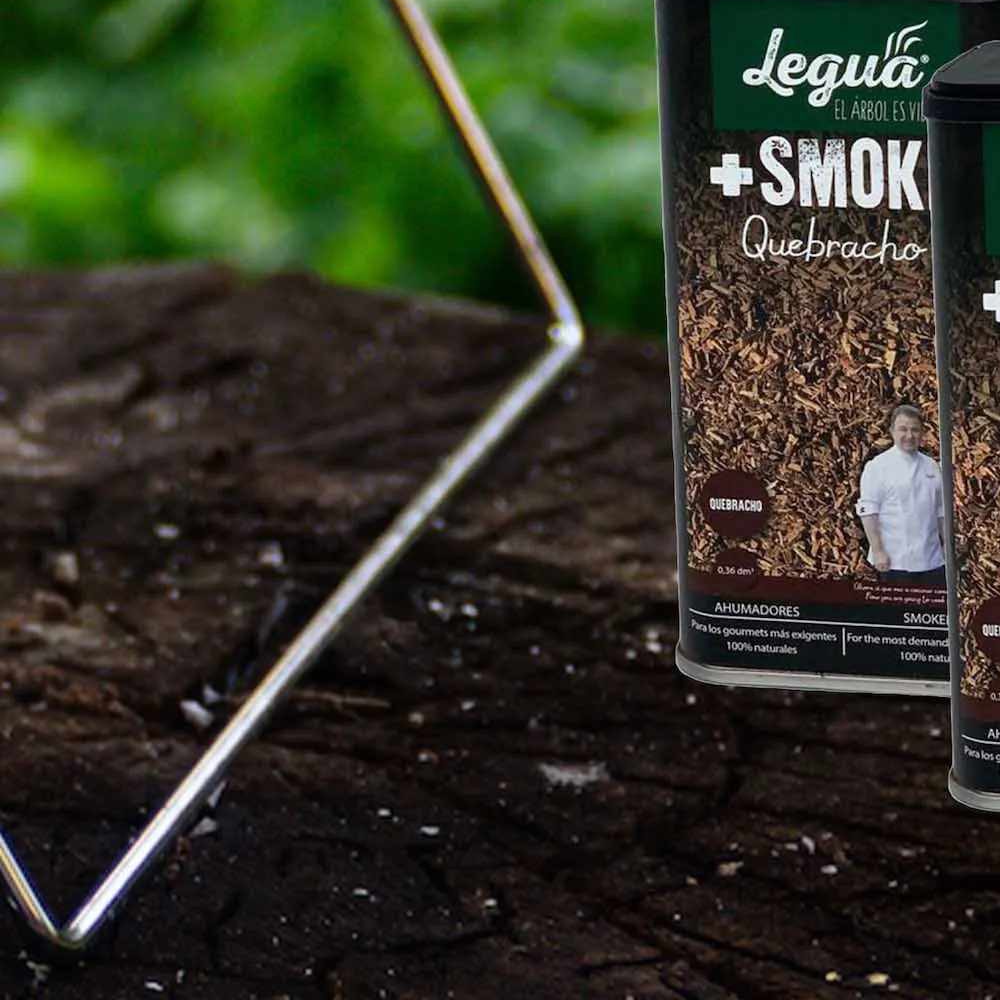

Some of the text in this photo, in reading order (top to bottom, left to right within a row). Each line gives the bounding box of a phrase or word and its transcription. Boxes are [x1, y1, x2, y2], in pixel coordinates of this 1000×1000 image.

[834, 99, 847, 120] EL
[893, 100, 906, 121] ES
[909, 101, 927, 121] VI
[710, 135, 931, 211] +SMOK
[742, 214, 928, 265] Quebracho
[709, 497, 763, 512] QUEBRACHO
[714, 601, 800, 617] AHUMADORES
[903, 612, 949, 625] SMOKE
[691, 619, 707, 632] Para
[708, 623, 721, 634] los
[723, 626, 769, 638] gourmets
[791, 629, 838, 642] exigentes
[726, 641, 798, 654] 100% naturales
[847, 632, 950, 648] For the most demand
[901, 651, 950, 663] 100% natu
[964, 745, 980, 758] Para
[981, 748, 995, 760] los
